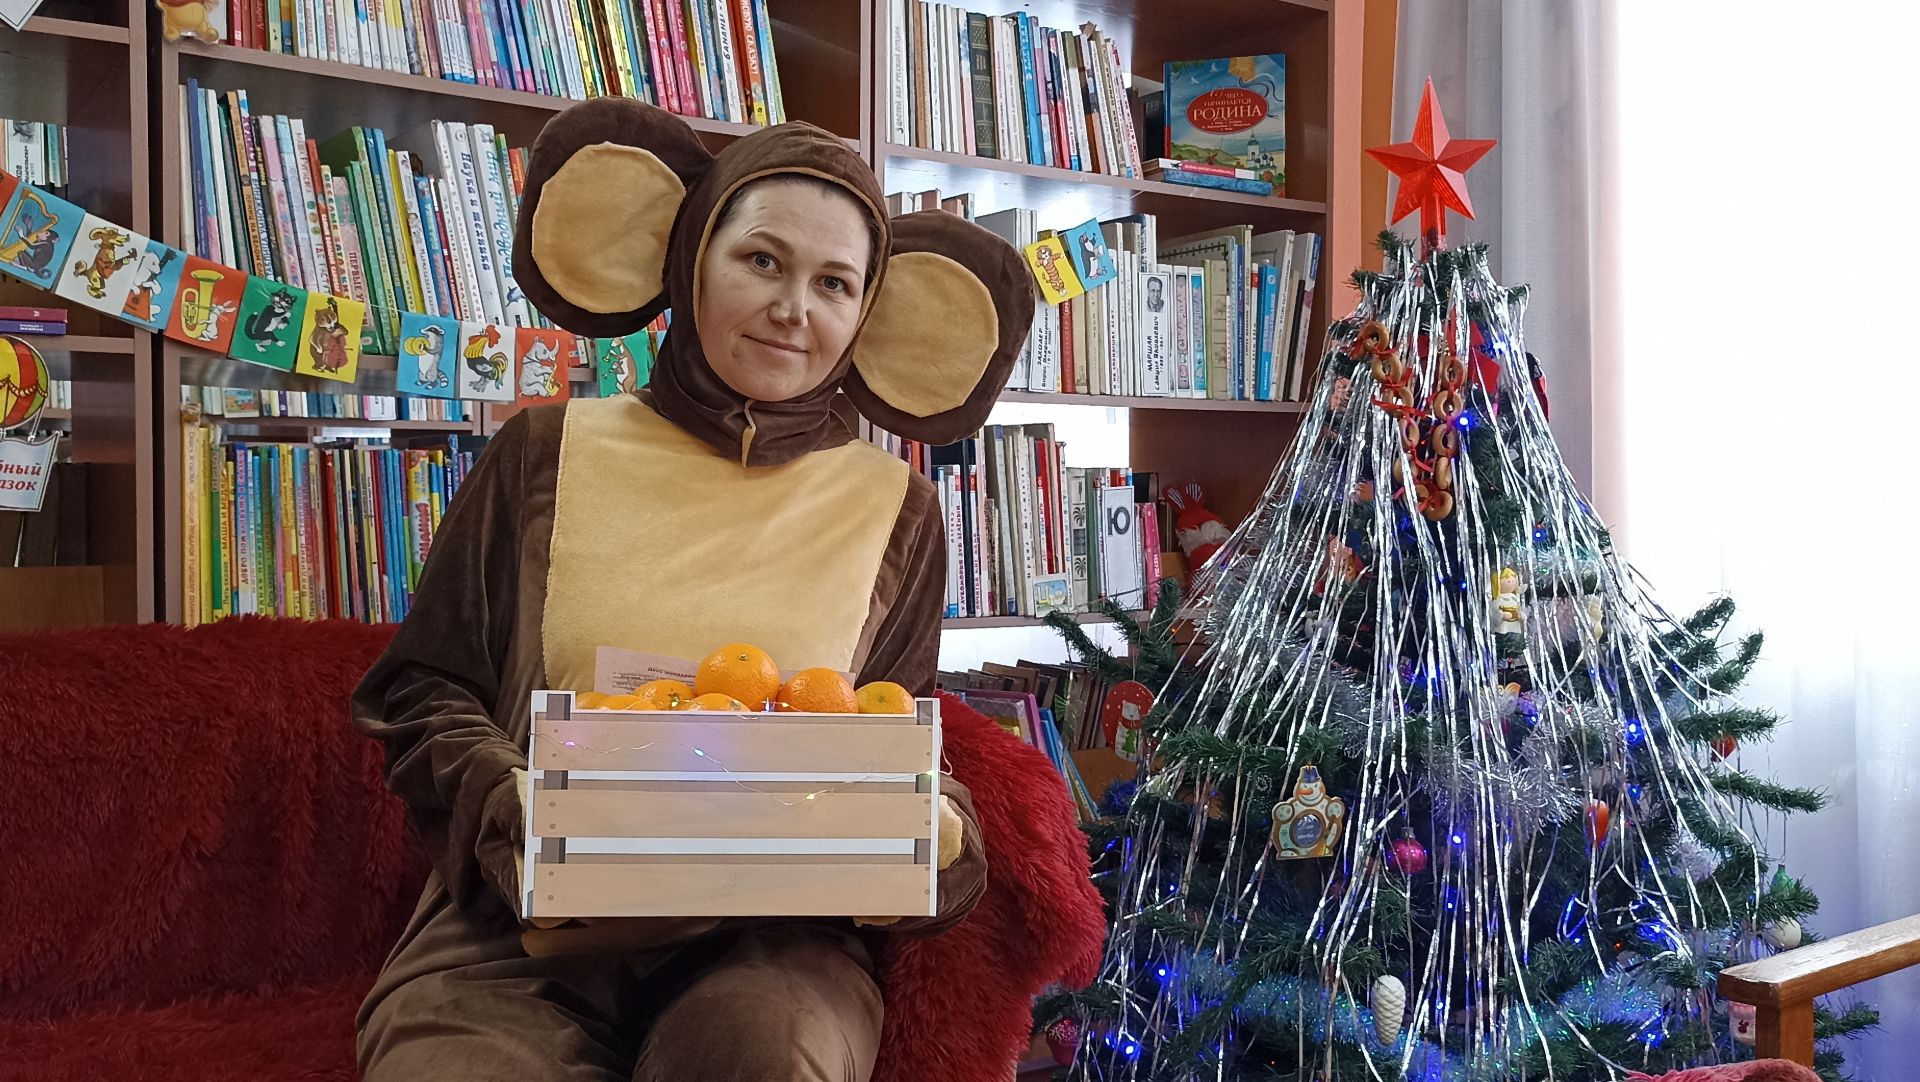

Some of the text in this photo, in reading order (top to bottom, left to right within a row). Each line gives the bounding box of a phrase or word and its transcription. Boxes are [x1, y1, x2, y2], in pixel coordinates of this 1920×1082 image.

[1193, 104, 1263, 121] РОДИНА
[485, 150, 501, 185] мир
[461, 151, 491, 271] Наука и техника
[487, 192, 513, 279] Подводный
[349, 251, 362, 291] ПЕРВЫЕ
[238, 495, 248, 554] ПОЖАЛОВАТЬ
[1106, 507, 1130, 536] Ю
[240, 557, 249, 585] ДОБРО
[299, 543, 308, 597] Владимир
[958, 559, 966, 604] ЛУКОМОРЬЯ
